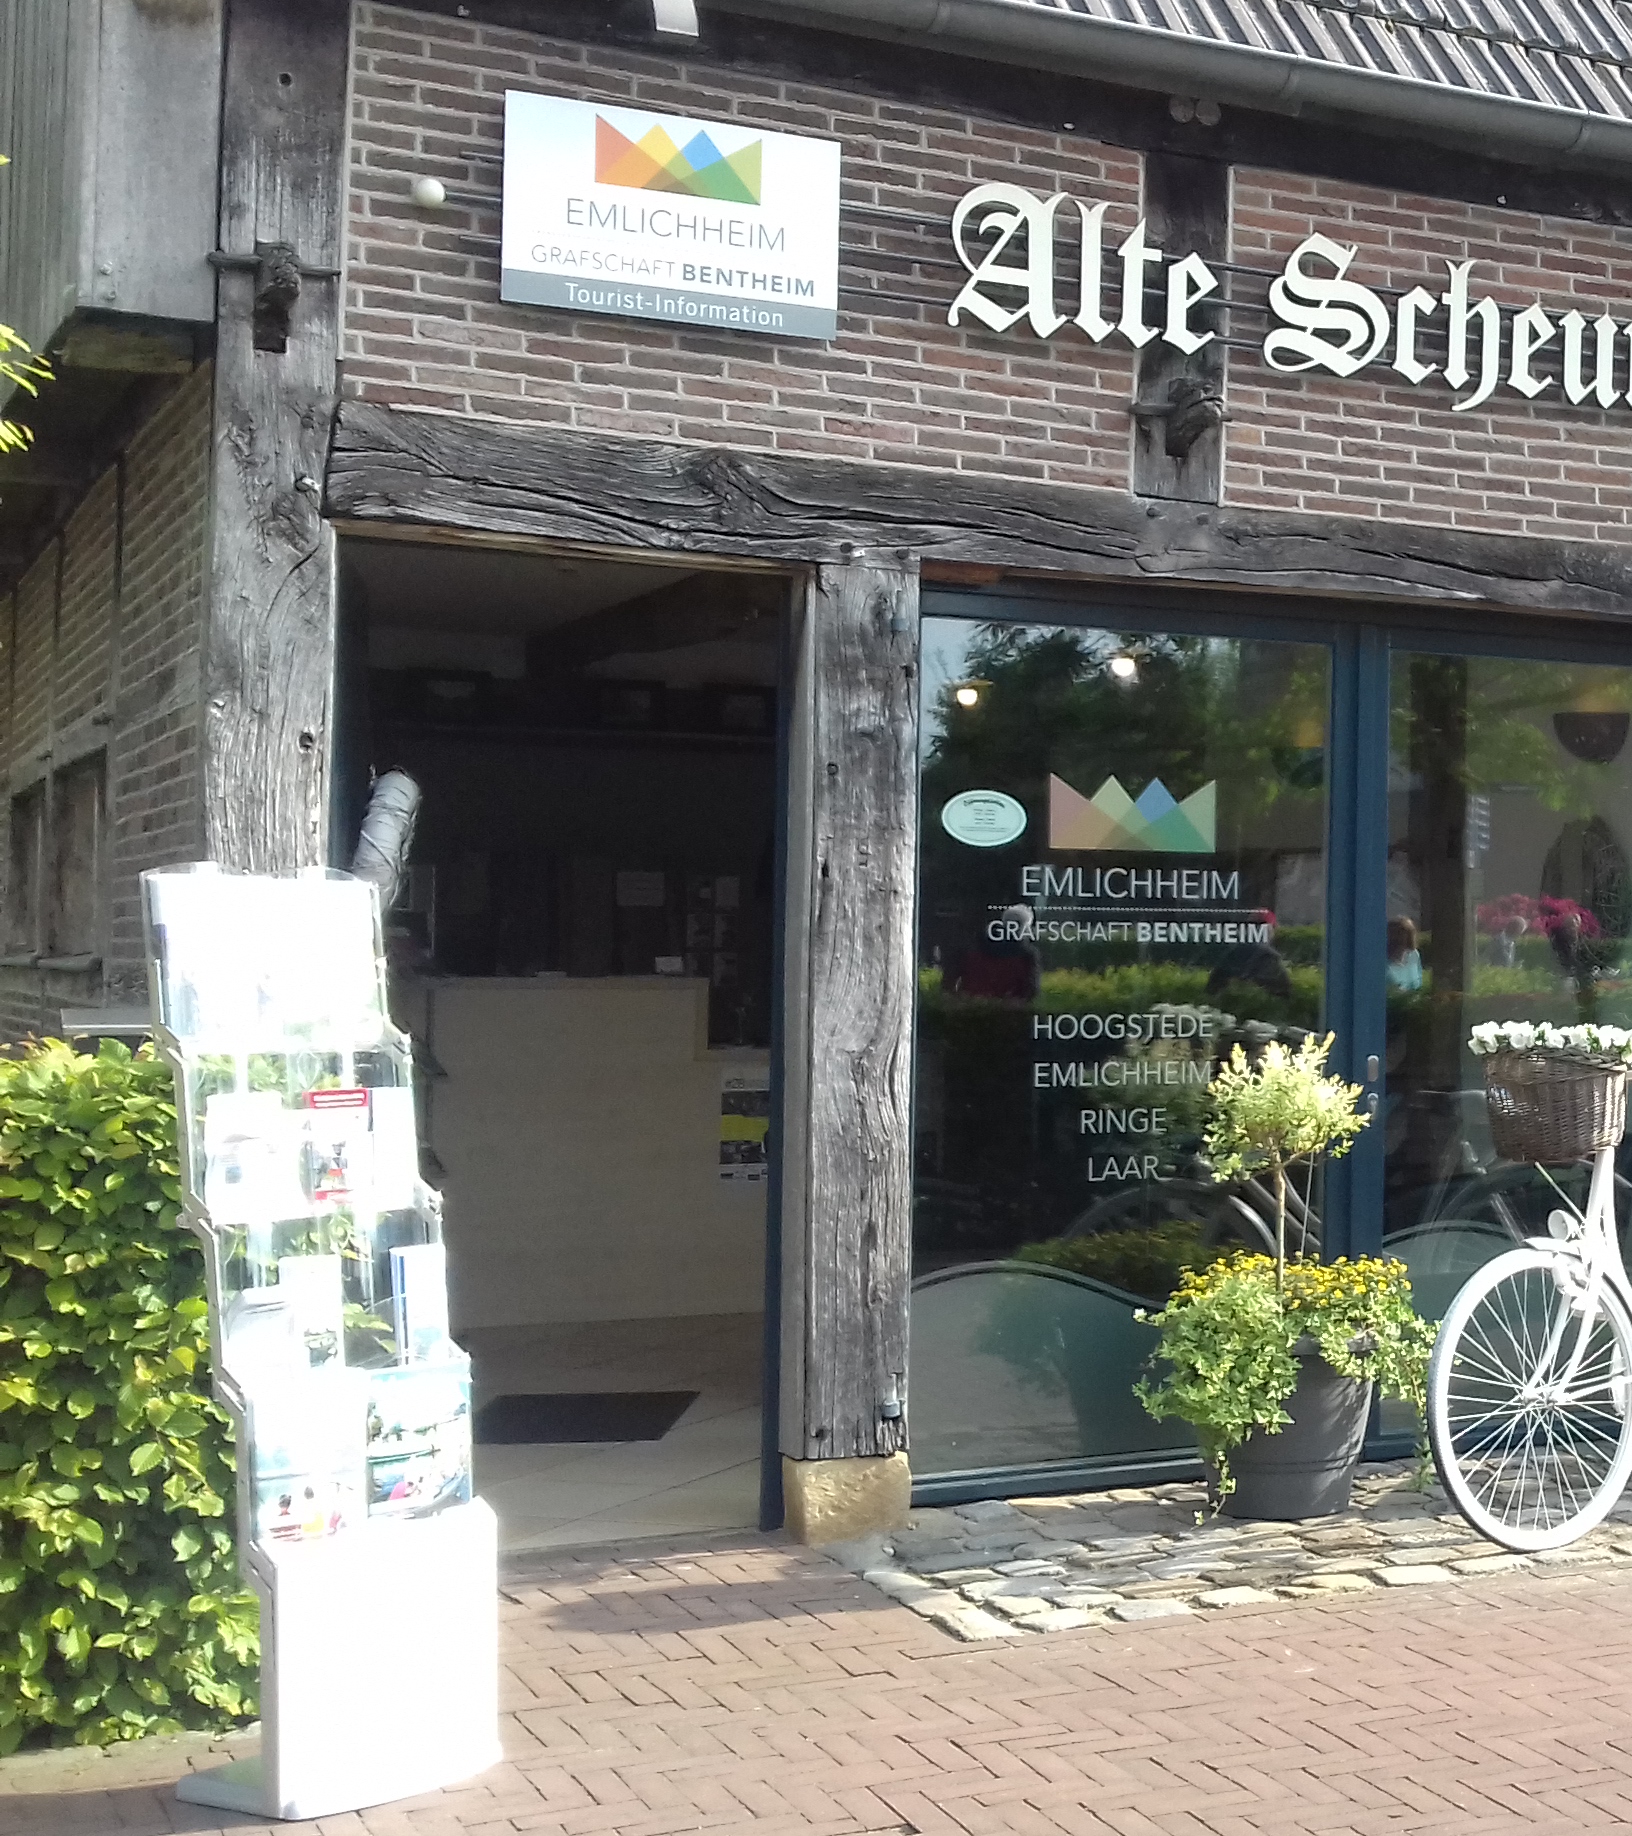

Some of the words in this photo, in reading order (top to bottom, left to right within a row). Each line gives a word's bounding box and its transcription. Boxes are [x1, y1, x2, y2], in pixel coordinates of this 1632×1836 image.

[566, 198, 785, 253] EMLICHHEIM
[531, 244, 676, 279] GRAFSCHAFT
[682, 262, 815, 298] BENTHEIM
[947, 182, 1219, 356] Alte
[565, 282, 784, 328] Tourist-Information
[1021, 866, 1239, 901] EMLICHHEIM
[987, 919, 1133, 943] GRAFSCHAFT
[1136, 922, 1269, 945] BENTHEIM
[1033, 1013, 1213, 1042] HOOGSTEDE
[1033, 1060, 1212, 1088] EMLICHHEIM
[1079, 1108, 1168, 1134] RINGE
[1088, 1155, 1160, 1182] LAAR
